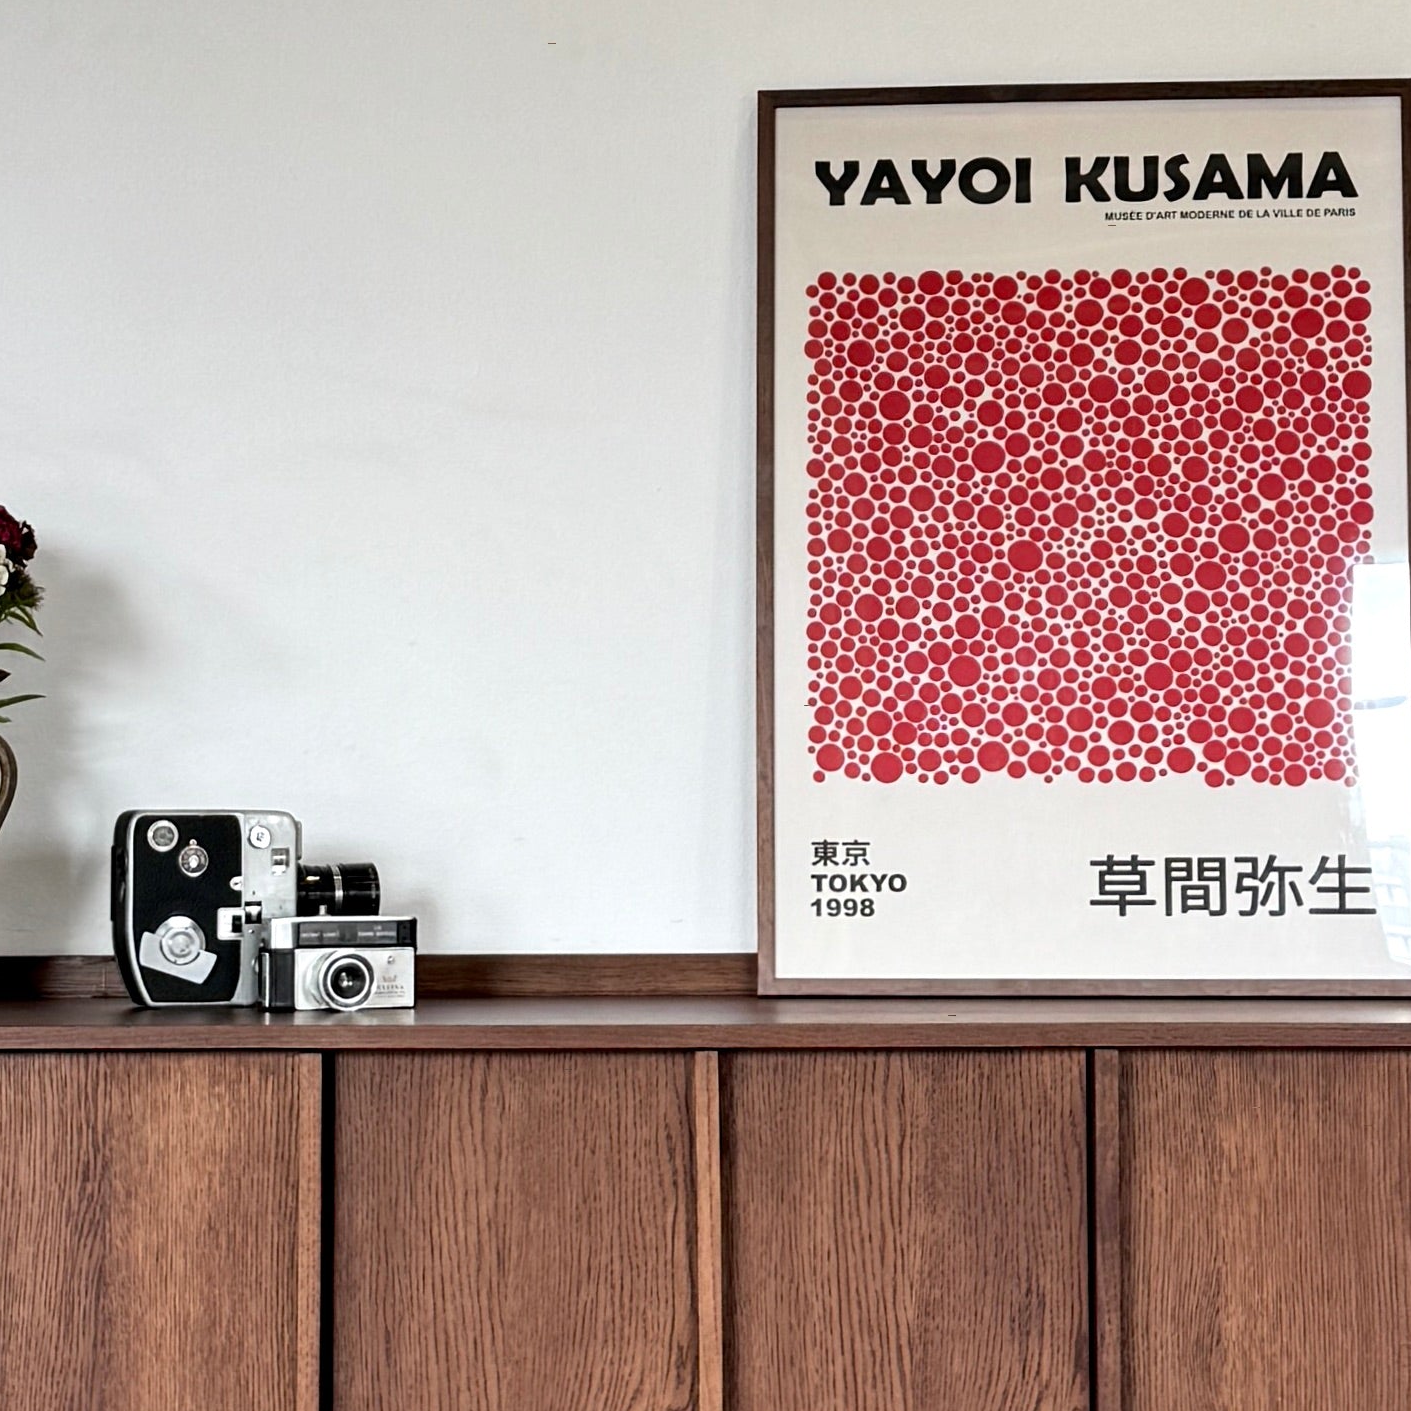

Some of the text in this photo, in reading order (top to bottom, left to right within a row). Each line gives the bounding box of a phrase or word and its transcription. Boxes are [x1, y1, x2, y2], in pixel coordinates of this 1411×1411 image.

[814, 151, 1359, 207] YAYOI KUSAMA
[1145, 210, 1177, 220] D'ART
[1180, 209, 1235, 220] MODERNE
[1238, 209, 1253, 219] DE
[1256, 209, 1271, 219] LA
[1273, 208, 1303, 218] VILLE
[1306, 208, 1321, 218] DE
[1323, 207, 1356, 218] PARIS
[811, 839, 871, 867] 東京
[810, 873, 907, 893] TOKYO
[1089, 854, 1377, 917] 草間弥生
[810, 898, 875, 918] 1998
